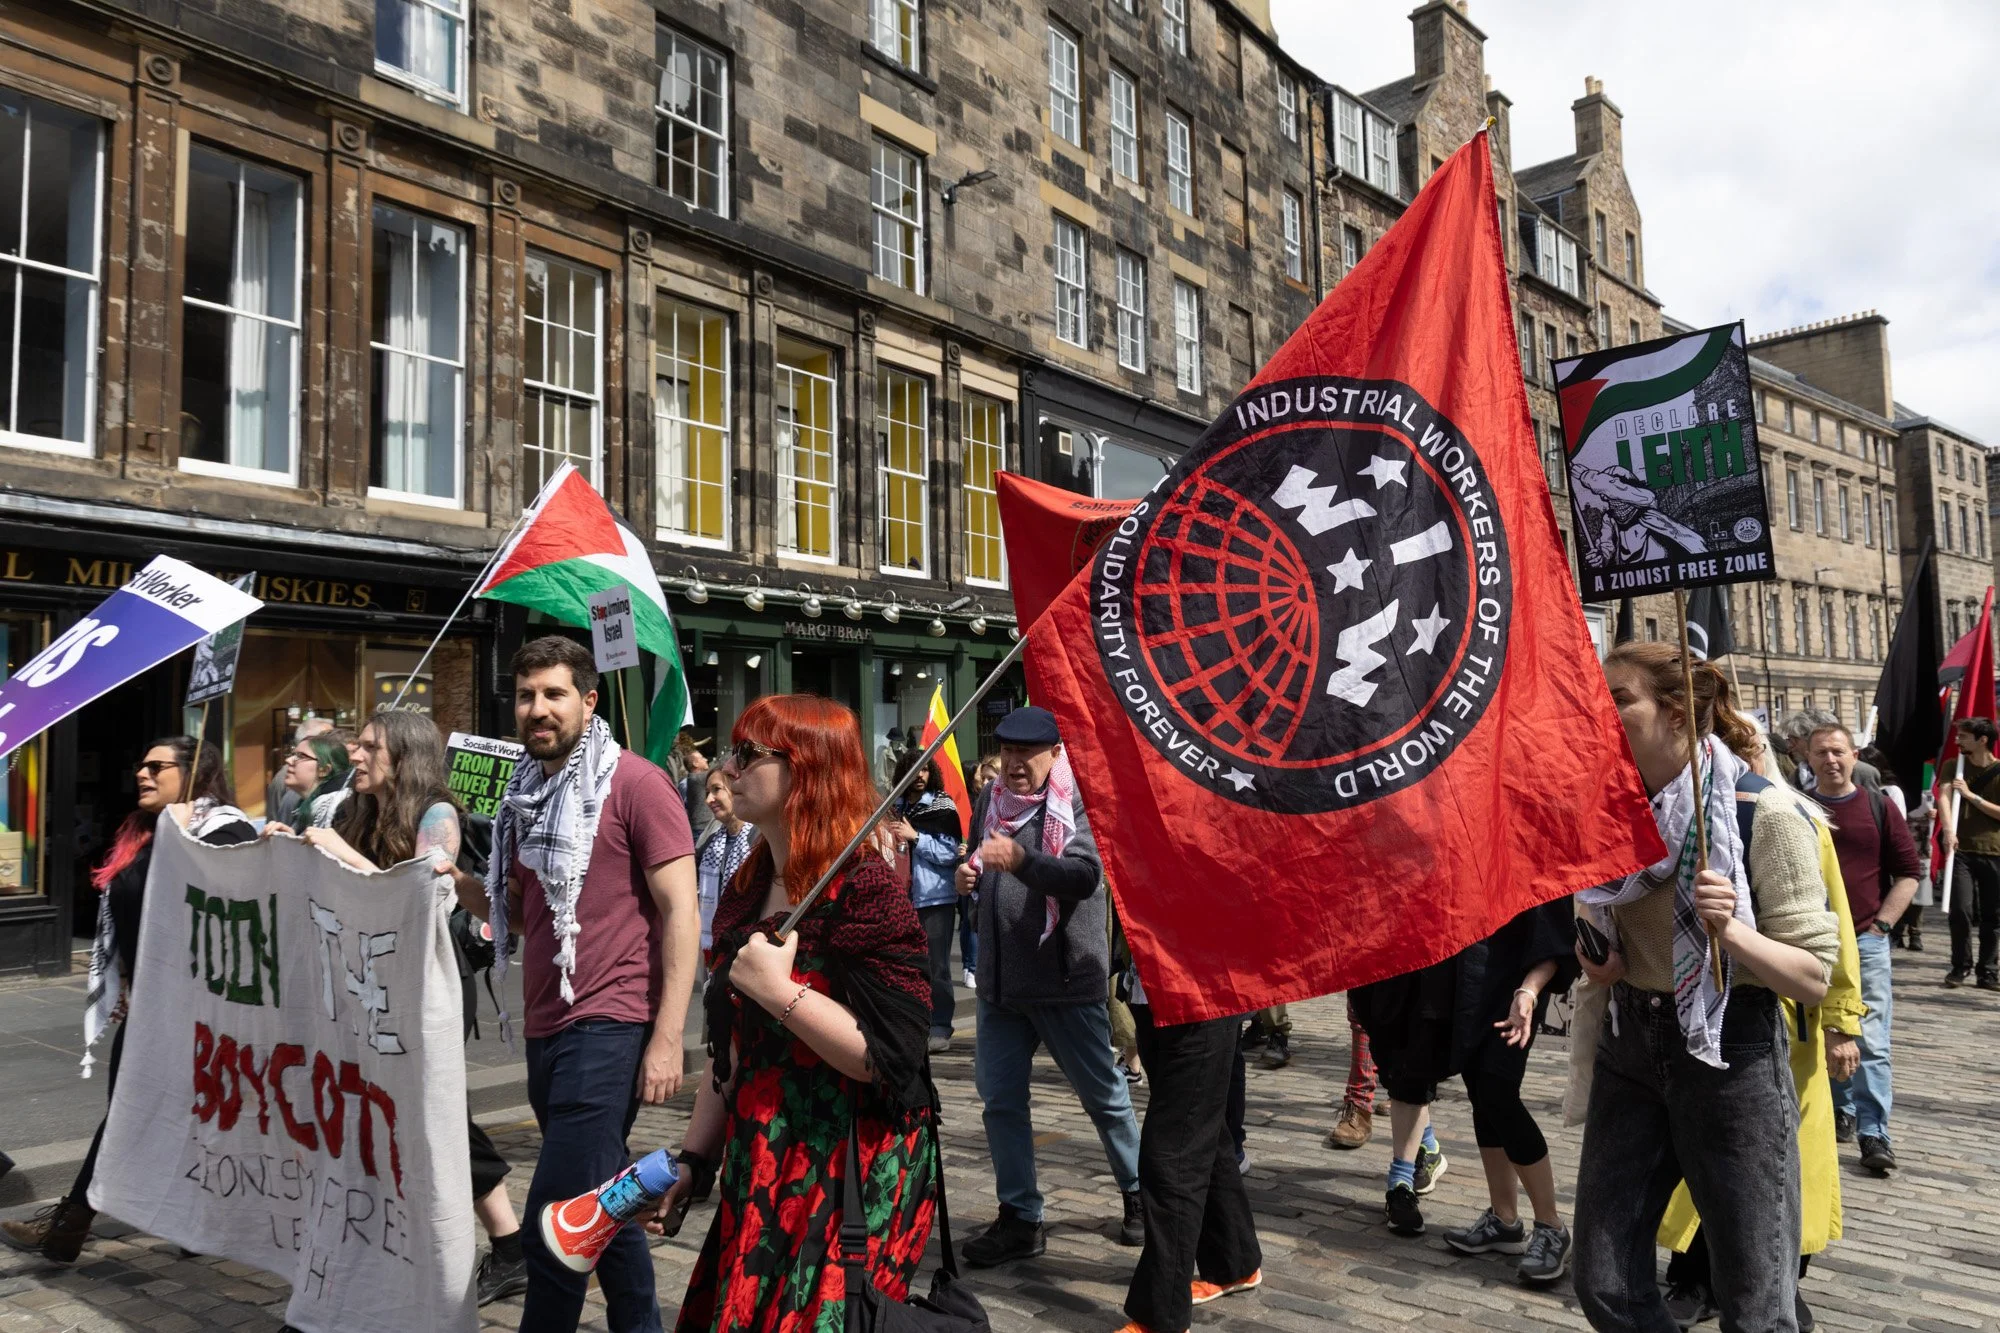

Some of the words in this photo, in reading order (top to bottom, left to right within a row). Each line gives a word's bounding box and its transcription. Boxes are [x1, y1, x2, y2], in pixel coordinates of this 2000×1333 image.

[1236, 386, 1417, 432] INDUSTRIAL
[1615, 399, 1738, 439] DECLARE
[1419, 423, 1501, 586] WORKERS
[141, 570, 204, 609] Worker
[1100, 501, 1149, 661] SOLIDARITY
[1594, 575, 1604, 592] A
[1610, 565, 1671, 588] ZIONIST
[1678, 559, 1718, 580] FREE
[1724, 552, 1768, 574] ZONE
[603, 619, 623, 643] Israel
[1478, 597, 1501, 645] OF
[1443, 653, 1493, 720] THE
[1115, 667, 1221, 780] FOREVER
[452, 751, 495, 776] FROM
[463, 738, 498, 753] Socialist
[498, 744, 521, 757] Work
[1334, 719, 1454, 798] WORLD
[448, 770, 490, 796] RIVER
